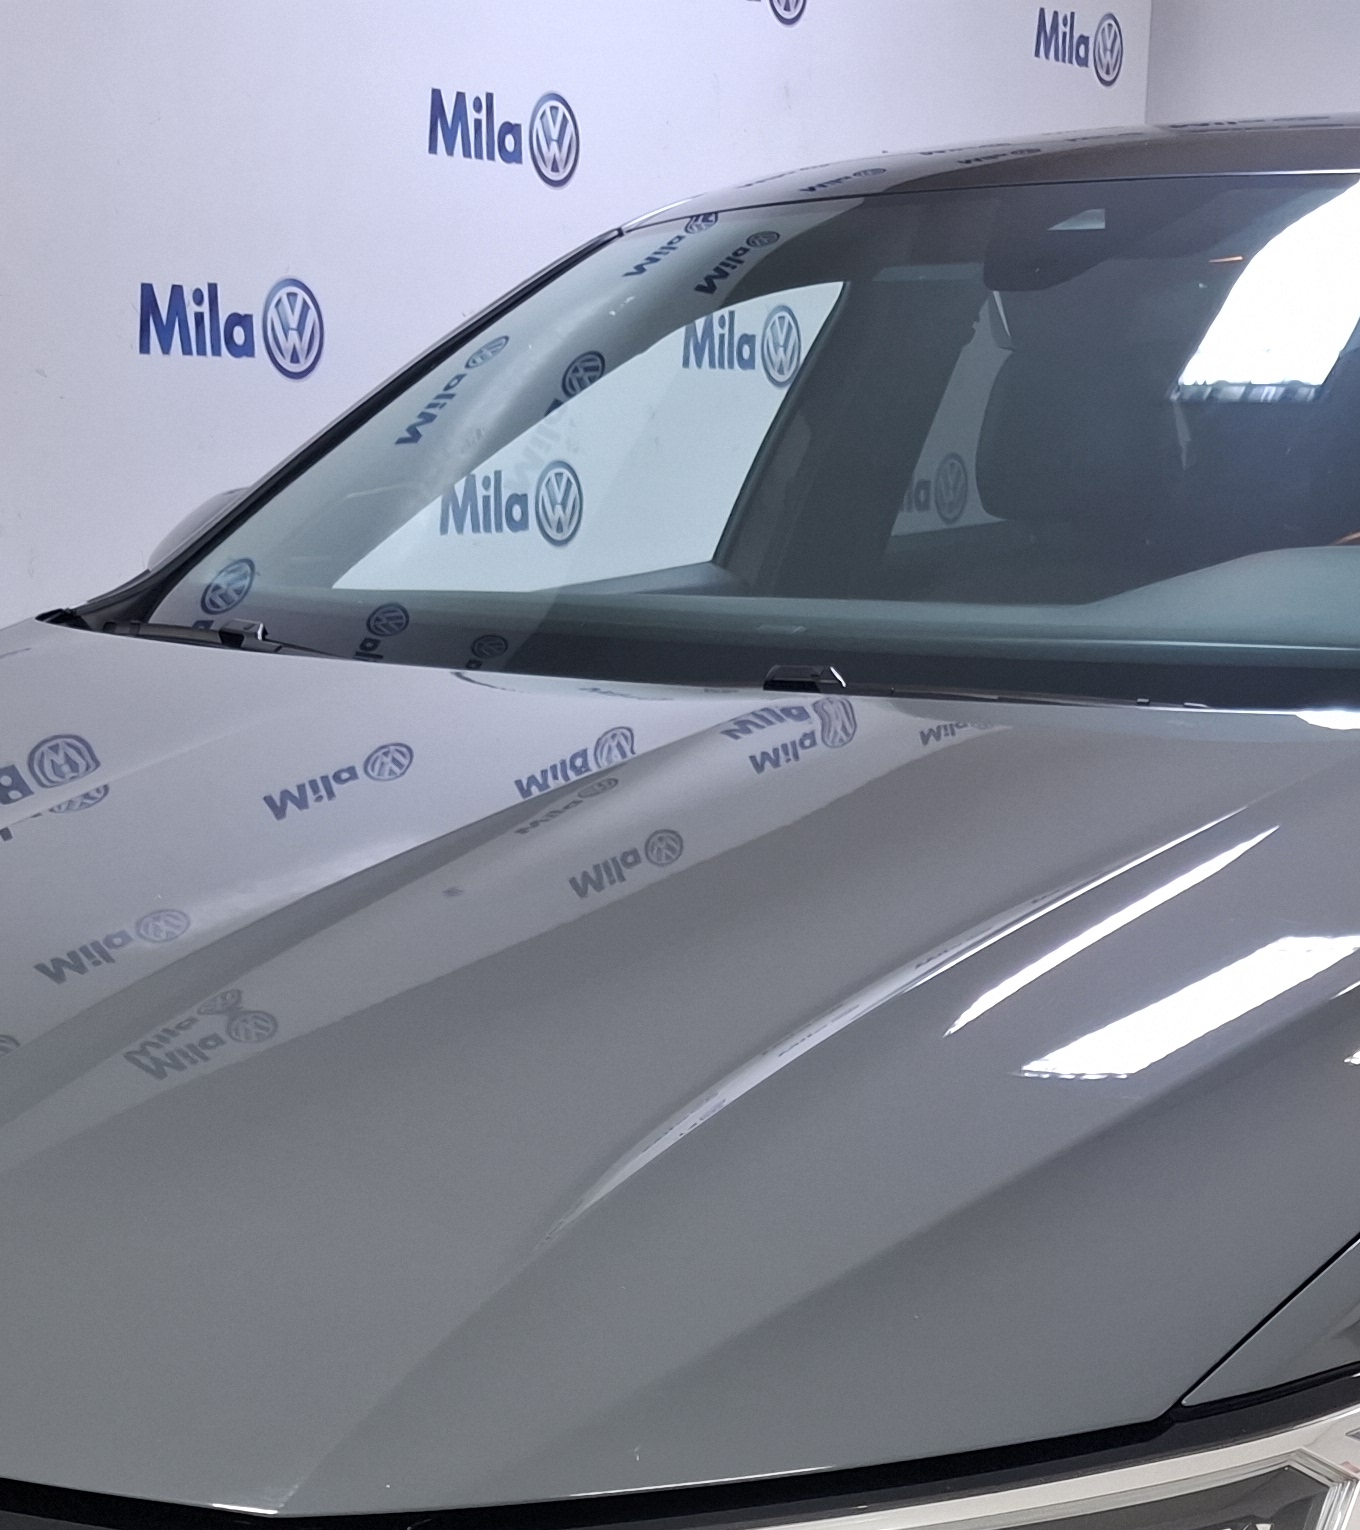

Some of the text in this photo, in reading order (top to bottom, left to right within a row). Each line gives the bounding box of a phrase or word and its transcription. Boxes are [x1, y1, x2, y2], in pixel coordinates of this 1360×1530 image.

[1035, 10, 1090, 69] Mila
[428, 88, 522, 165] Mila
[139, 283, 255, 359] Mila
[682, 310, 756, 370] Mila
[440, 470, 529, 535] Mila
